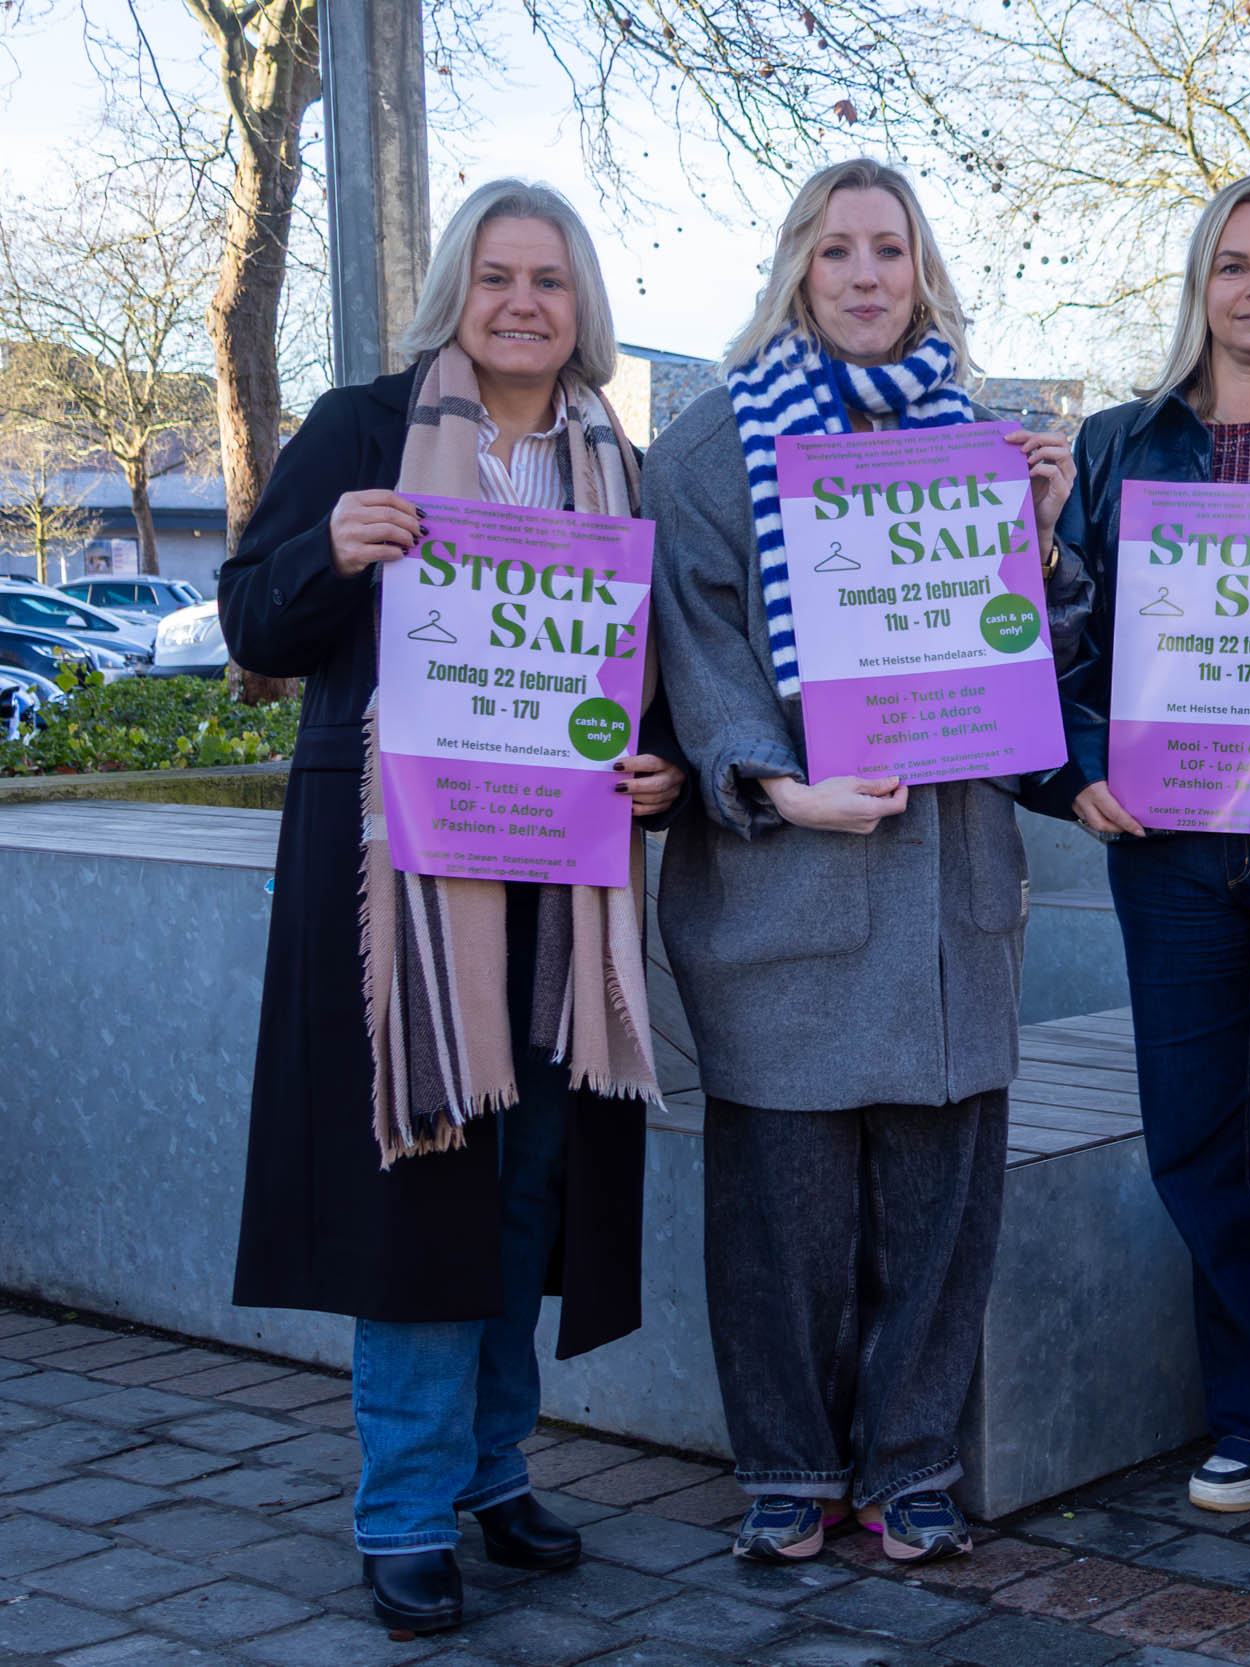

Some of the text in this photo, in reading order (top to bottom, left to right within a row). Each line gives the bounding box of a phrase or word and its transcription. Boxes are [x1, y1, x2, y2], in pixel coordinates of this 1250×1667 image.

[812, 472, 1003, 520] STOCK
[888, 519, 1031, 565] SALE
[419, 539, 618, 605] STOCK
[838, 575, 991, 607] Zondag 22 februari
[986, 613, 1033, 624] cash & pq
[490, 602, 637, 659] SALE
[1000, 625, 1022, 636] only!
[1157, 633, 1214, 655] Zondag
[1219, 636, 1239, 654] 22
[859, 648, 987, 668] Met Heistse handelaars:
[427, 660, 587, 695] Zondag 22 februari
[866, 693, 899, 707] Mooi
[911, 689, 944, 704] Tutti
[948, 690, 957, 699] e
[960, 685, 986, 698] due
[881, 712, 908, 724] LOF
[920, 709, 936, 721] Lo
[939, 704, 982, 719] Adoro
[1167, 704, 1186, 713] Met
[1189, 704, 1227, 714] Heistse
[575, 717, 625, 731] cash & pq
[867, 729, 929, 745] VFashion
[941, 720, 998, 738] Bell'Ami
[587, 731, 611, 742] only!
[1167, 740, 1200, 752] Mooi
[1212, 741, 1244, 753] Tutti
[436, 737, 570, 758] Met Heistse handelaars:
[1180, 760, 1205, 771] LOF
[1217, 761, 1233, 772] Lo
[436, 778, 471, 792] Mooi
[484, 781, 519, 795] Tutti
[522, 787, 531, 796] e
[535, 785, 562, 798] due
[1162, 777, 1223, 791] VFashion
[450, 800, 476, 812] LOF
[490, 802, 506, 814] Lo
[510, 804, 554, 817] Adoro
[432, 818, 495, 834] VFashion
[509, 824, 566, 839] Bell'Ami
